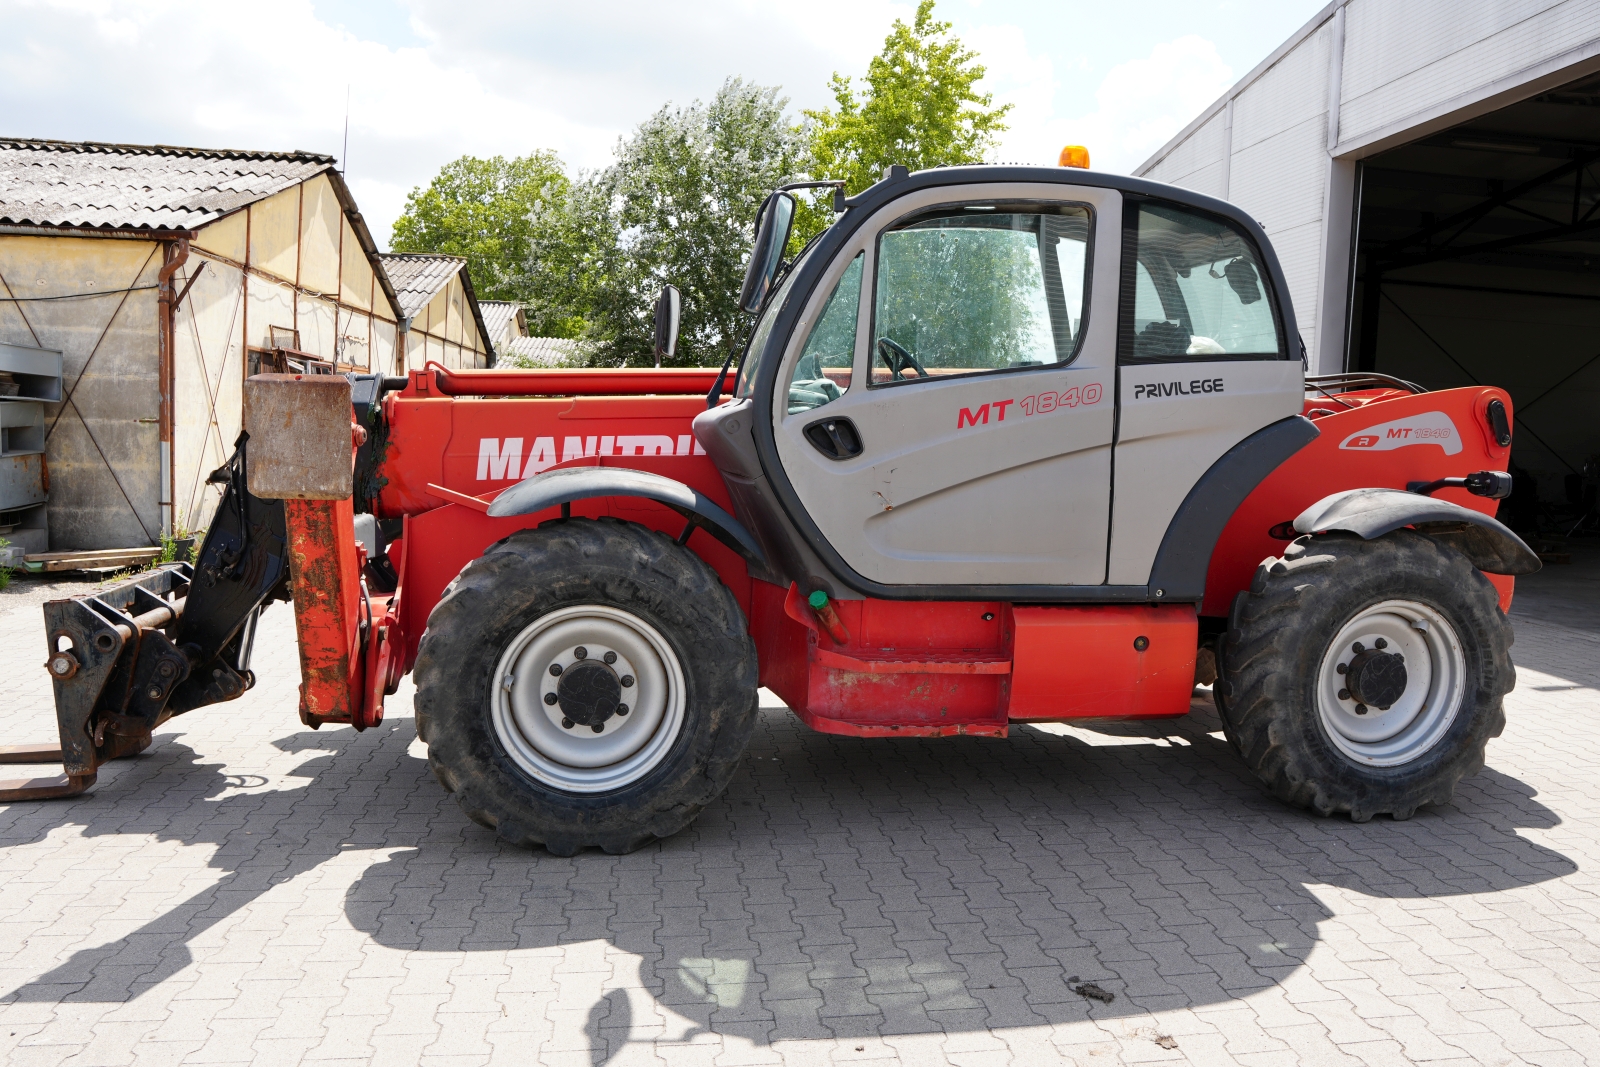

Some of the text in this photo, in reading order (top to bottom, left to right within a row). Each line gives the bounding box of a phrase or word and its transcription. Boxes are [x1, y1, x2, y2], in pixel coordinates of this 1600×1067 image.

[1134, 378, 1224, 399] PRIVILEGE
[957, 382, 1103, 429] MT 1840
[1387, 428, 1450, 438] MT 1840
[476, 435, 707, 481] MANIT
